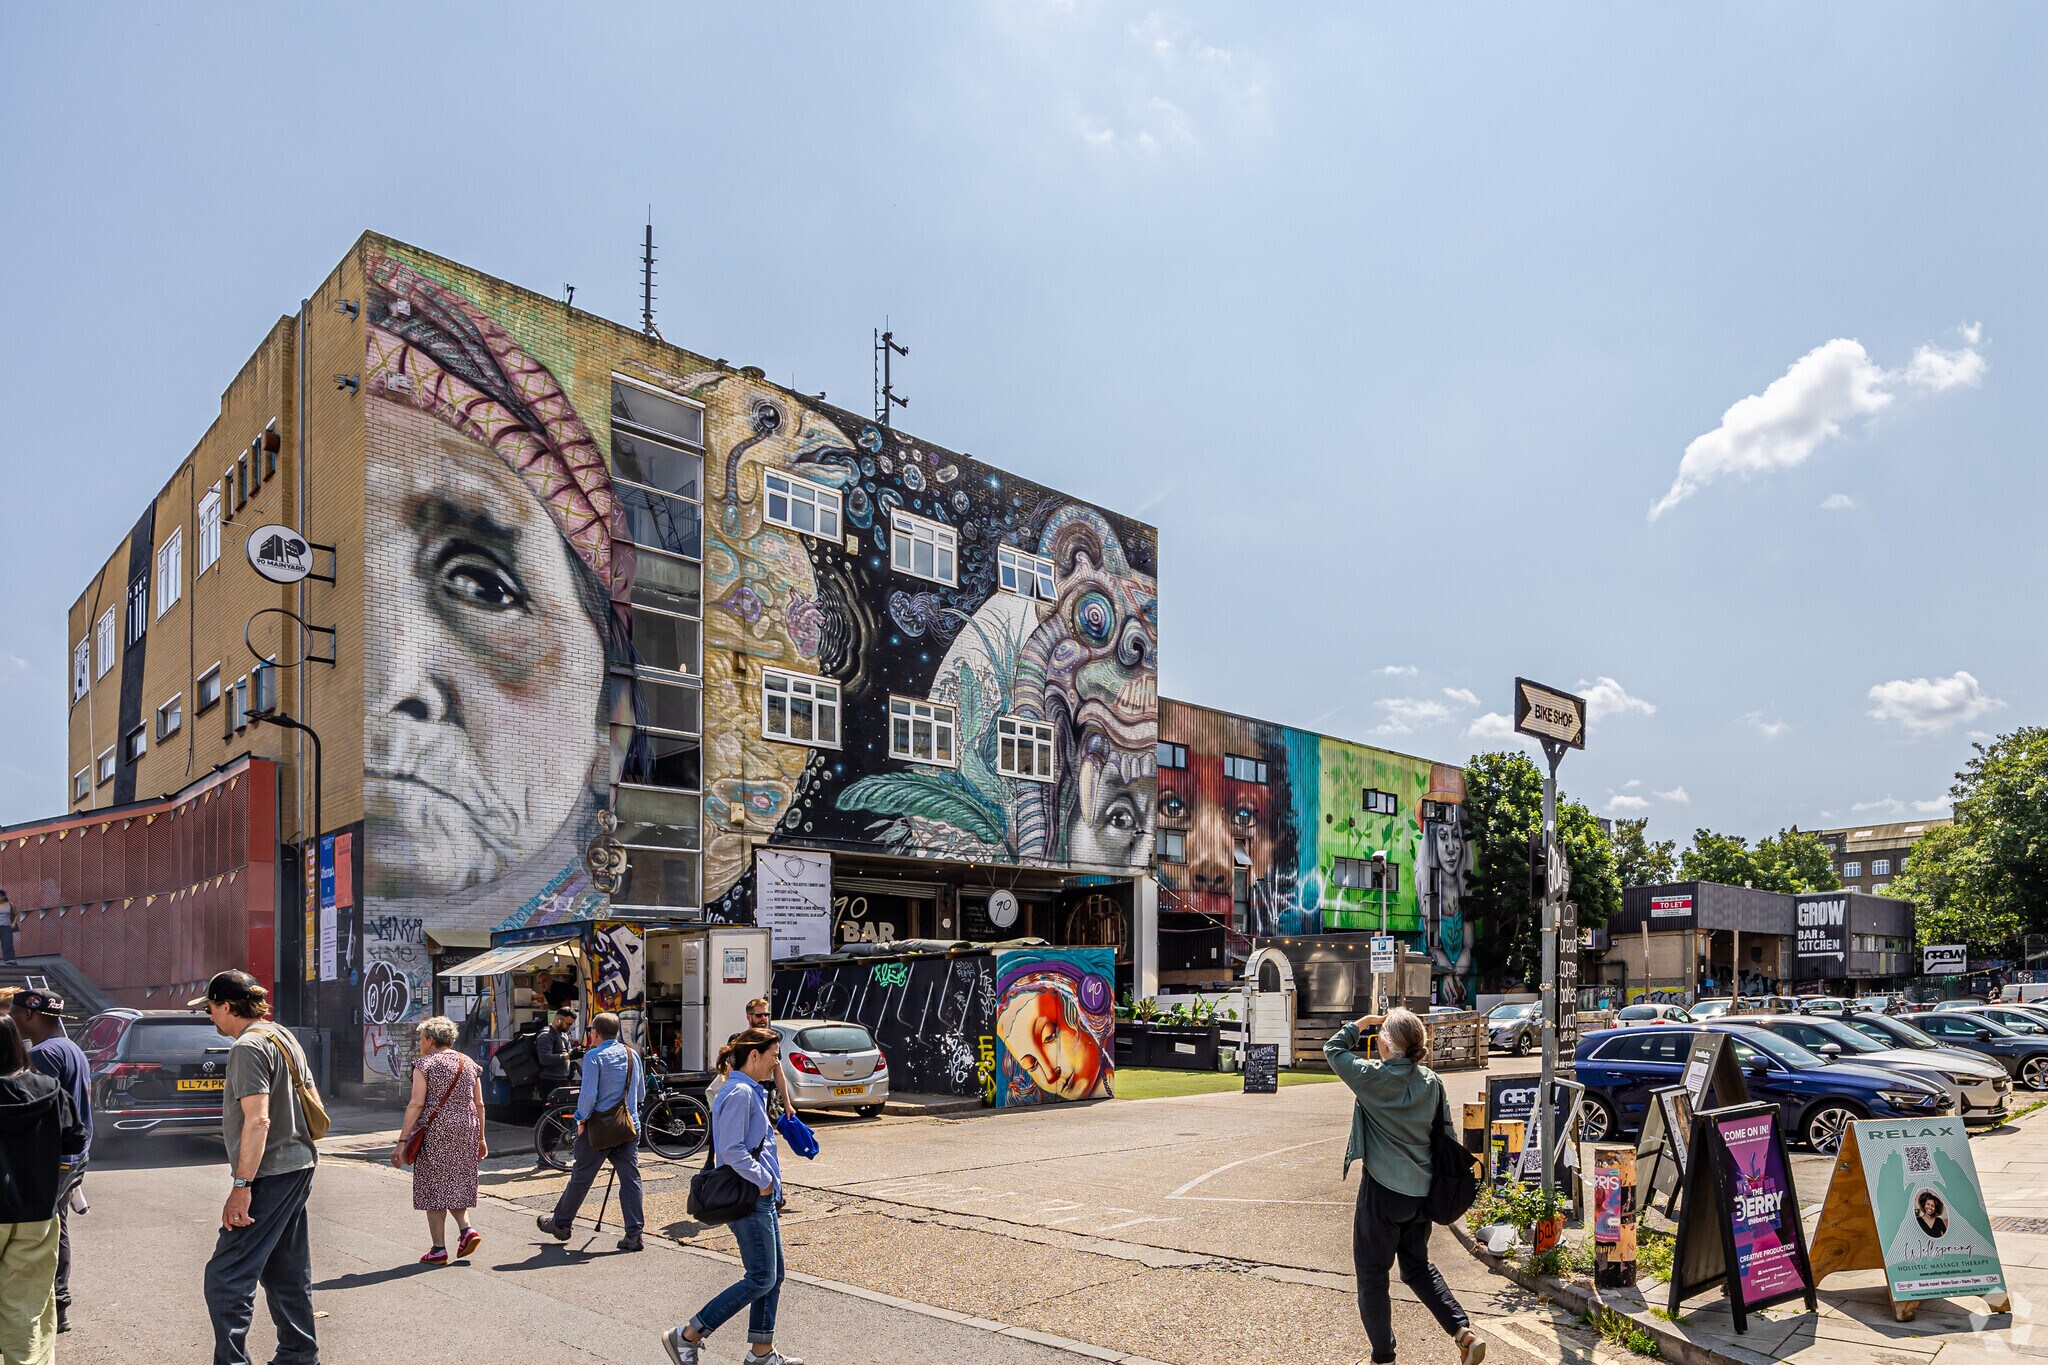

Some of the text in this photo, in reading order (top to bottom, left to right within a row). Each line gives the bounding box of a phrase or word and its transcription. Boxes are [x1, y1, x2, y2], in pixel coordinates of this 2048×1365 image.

[267, 560, 306, 572] MAINYARD
[1535, 704, 1573, 728] BIKE SHOP
[1798, 900, 1846, 926] GROW
[844, 921, 894, 943] BAR
[1798, 930, 1826, 940] BAR &
[1560, 929, 1577, 954] bread
[1798, 939, 1840, 951] KITCHEN
[1925, 950, 1965, 960] GROW
[1560, 979, 1577, 1003] bakes
[1560, 1005, 1577, 1029] lunch
[1252, 1046, 1274, 1059] WELCOME
[1724, 1124, 1769, 1141] COME ON IN!
[1868, 1126, 1954, 1140] RELAX
[1752, 1187, 1763, 1196] THE
[1734, 1190, 1783, 1222] BERRY
[1748, 1213, 1776, 1226] theberry.uk
[1740, 1243, 1795, 1263] CREATIVE PRODUCTION
[1904, 1240, 1975, 1264] Wellspring
